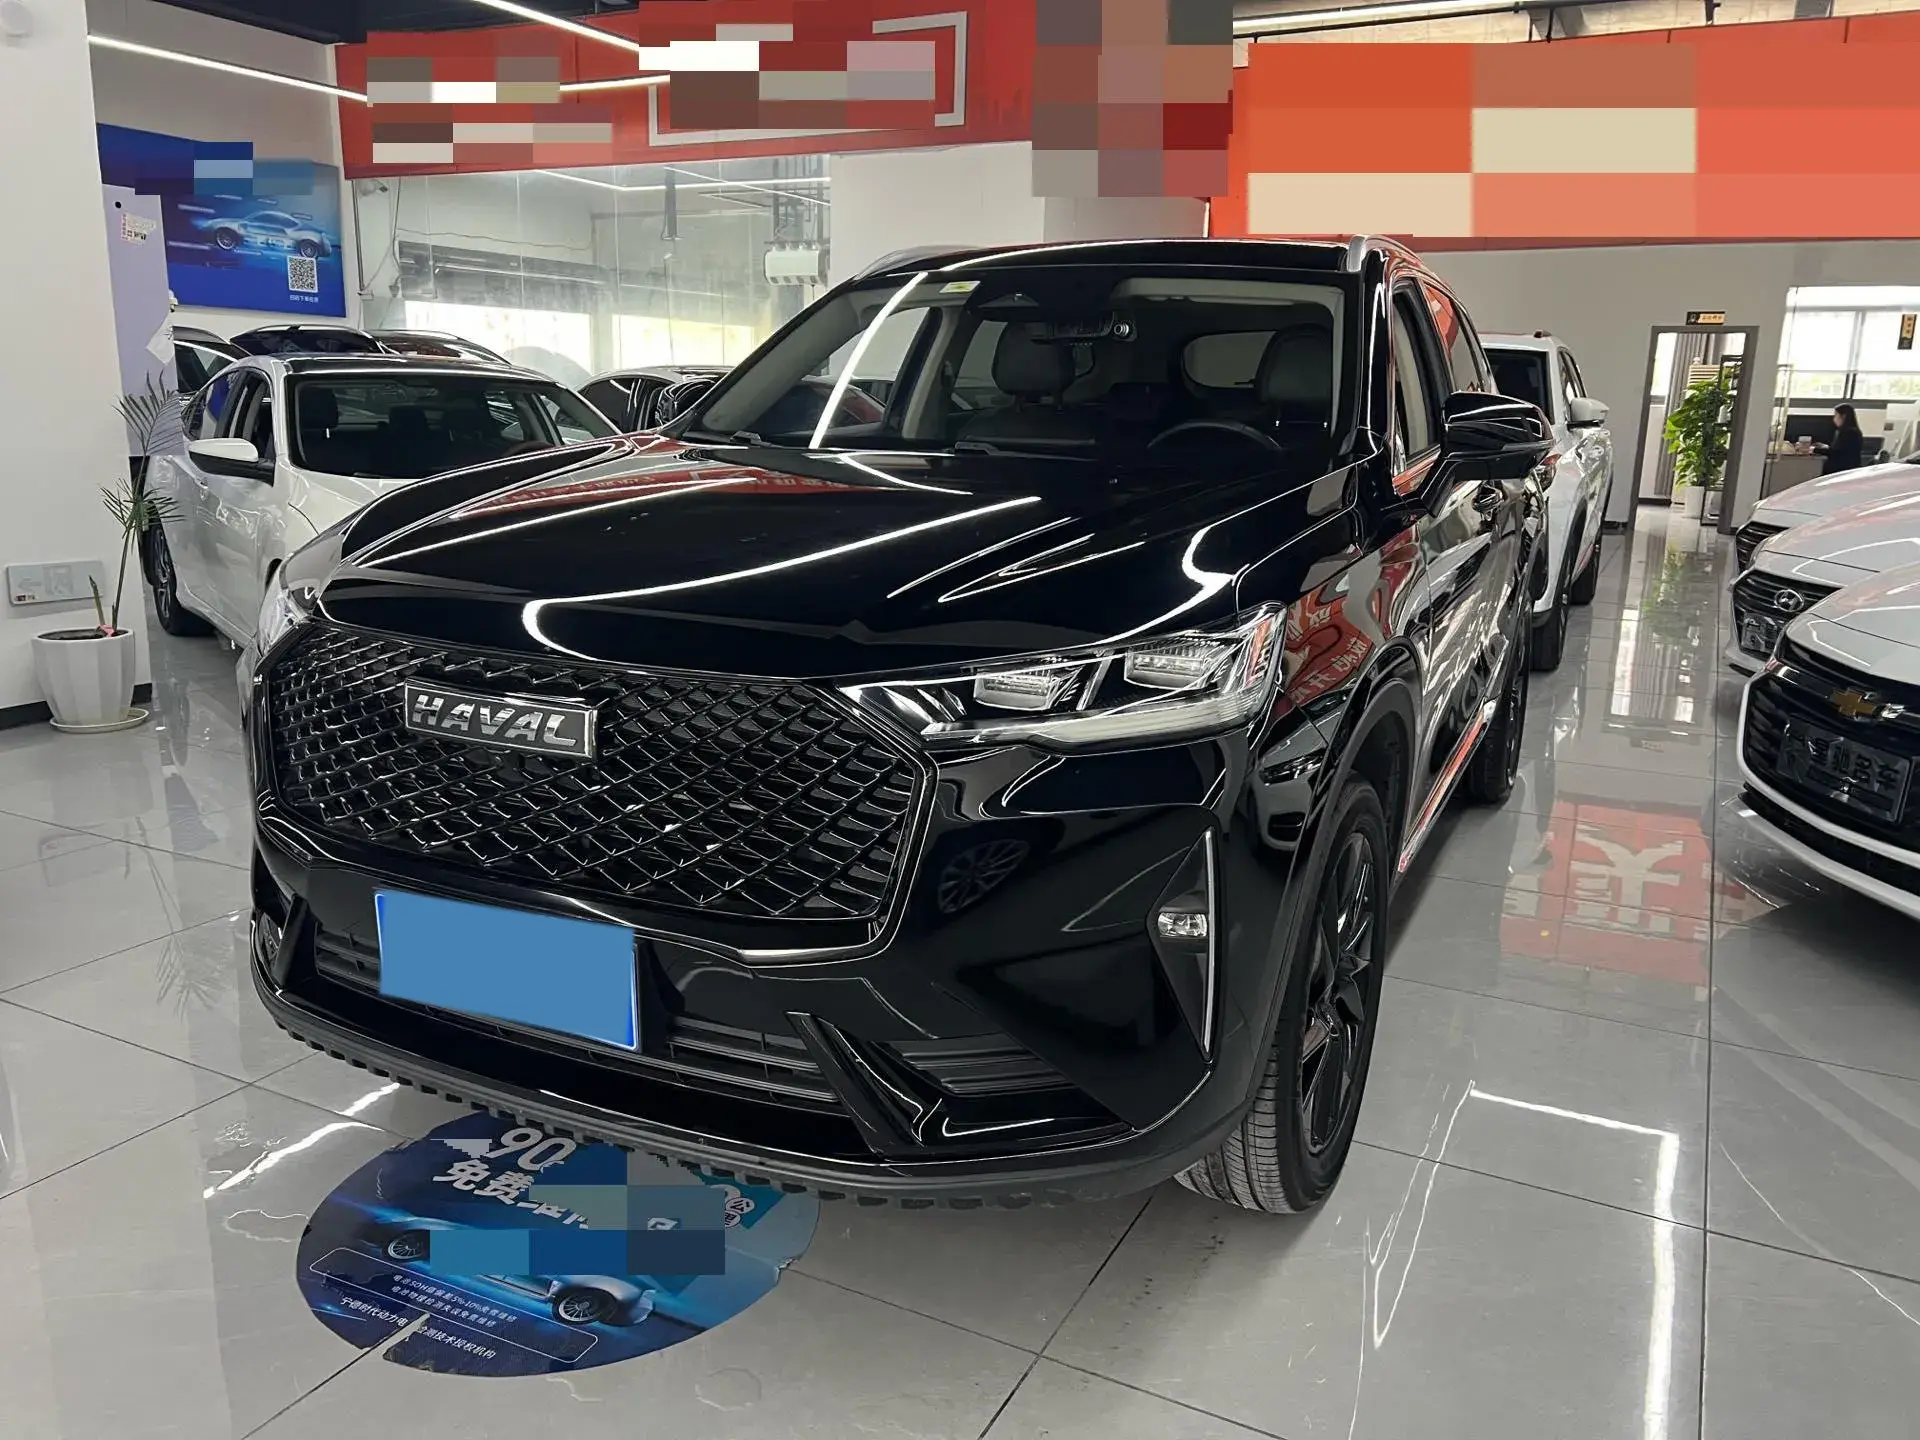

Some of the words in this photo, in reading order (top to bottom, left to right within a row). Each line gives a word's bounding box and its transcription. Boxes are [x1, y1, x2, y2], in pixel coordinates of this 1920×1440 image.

[412, 694, 577, 747] HAVAL
[484, 1127, 577, 1172] 90
[340, 1297, 497, 1360] 宁德时代动力电测技术授权机构
